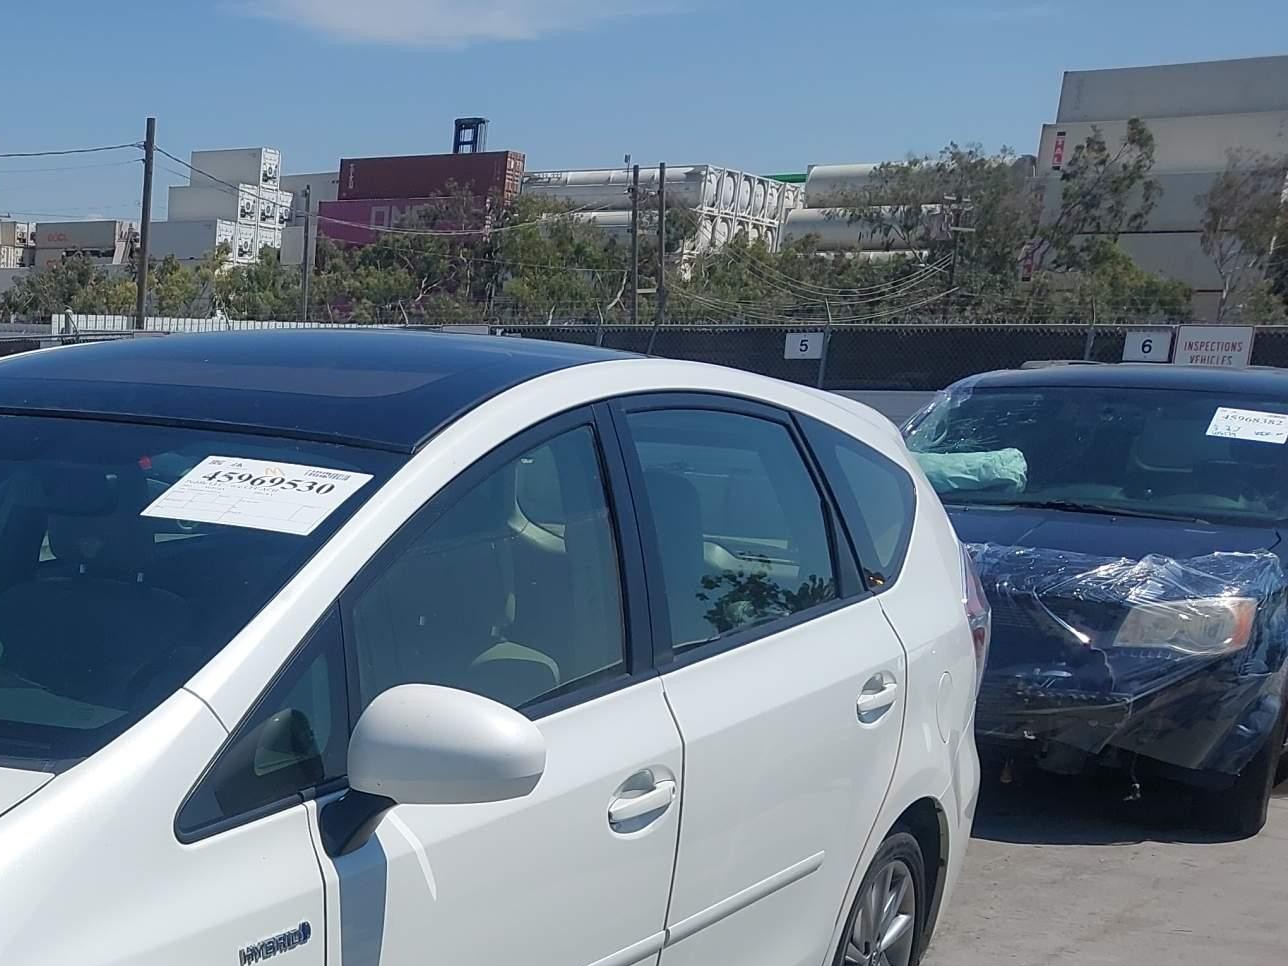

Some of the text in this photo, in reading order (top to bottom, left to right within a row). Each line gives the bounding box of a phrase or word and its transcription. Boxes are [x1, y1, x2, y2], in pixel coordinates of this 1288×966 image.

[799, 339, 809, 352] 5
[1141, 339, 1153, 353] 6
[1184, 341, 1242, 352] INSPECTIONS
[202, 470, 336, 495] 45969530
